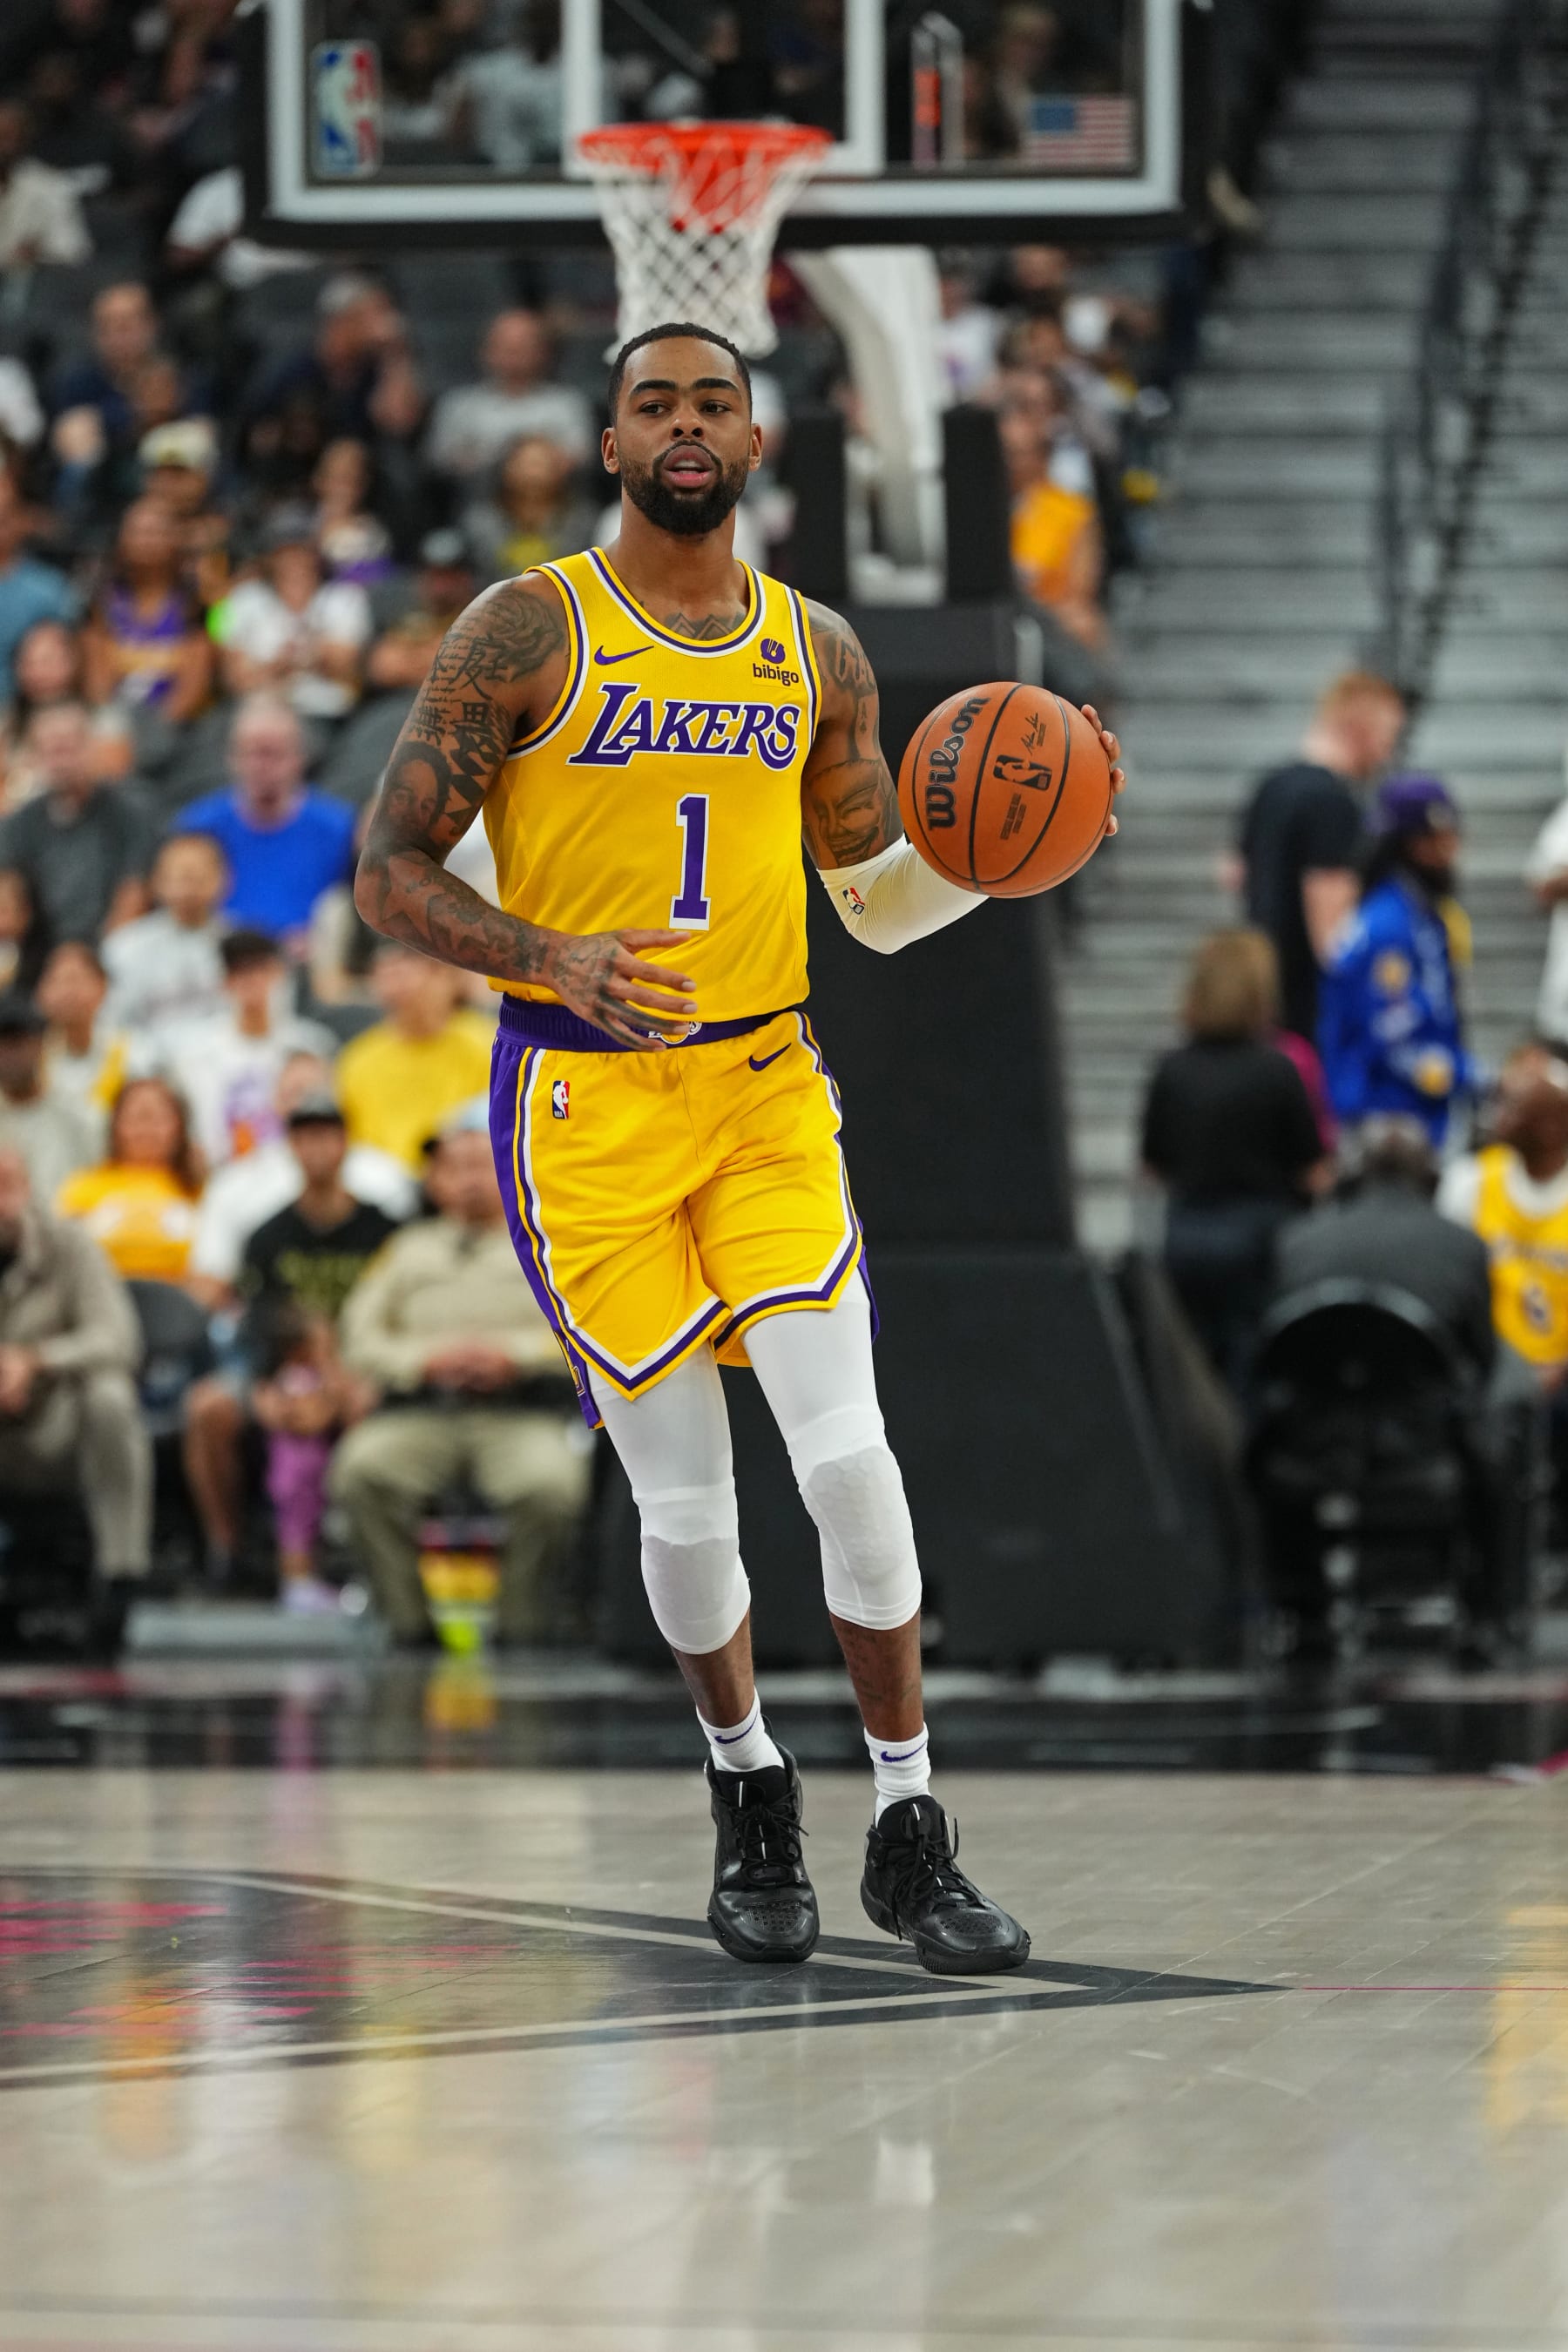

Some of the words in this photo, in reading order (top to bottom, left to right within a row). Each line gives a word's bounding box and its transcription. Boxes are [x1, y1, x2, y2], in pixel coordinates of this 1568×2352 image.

[566, 682, 801, 771] LAKERS
[752, 663, 800, 686] bibigo
[926, 697, 990, 831] Wilson
[669, 794, 711, 930] 1
